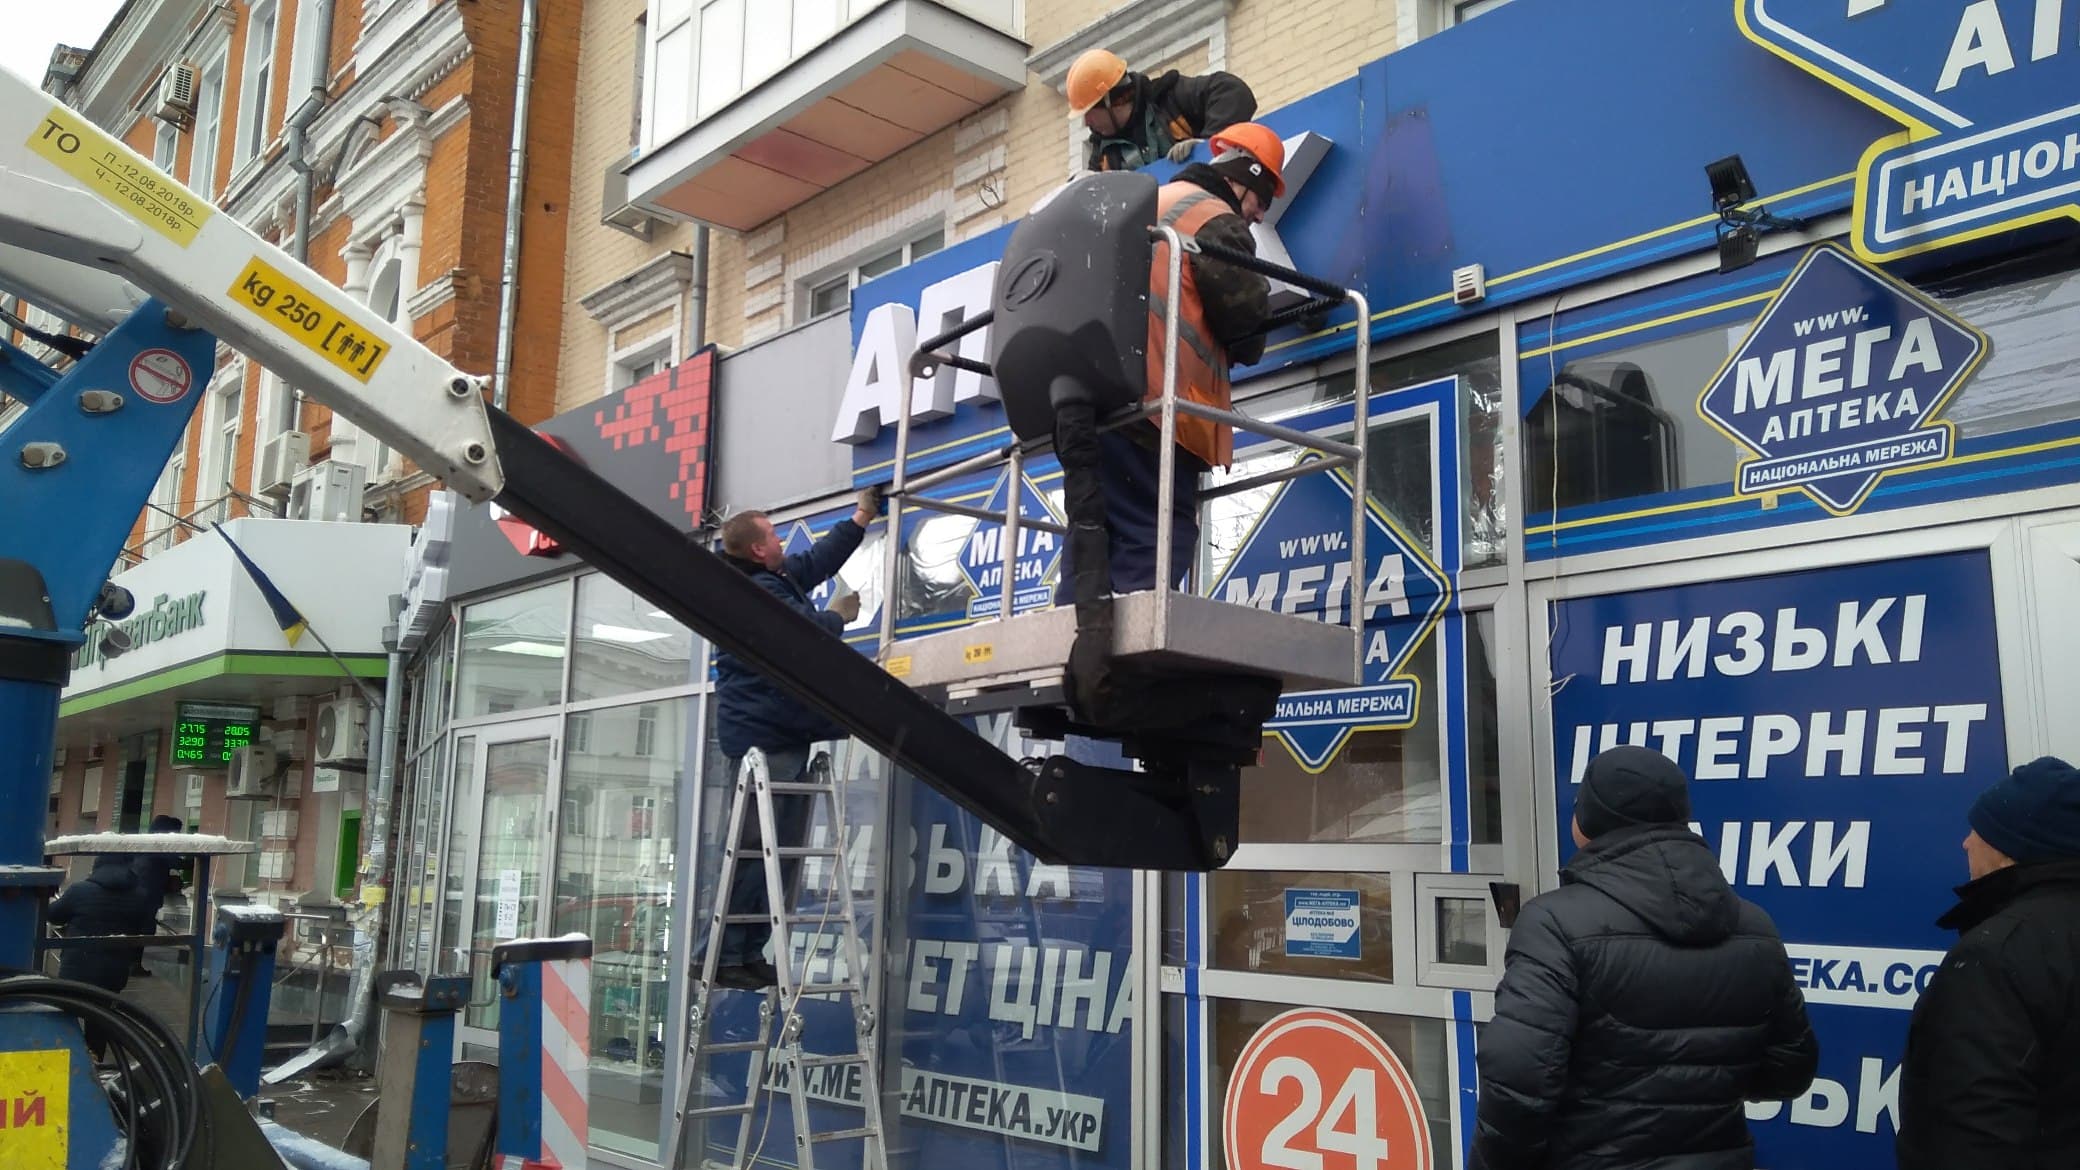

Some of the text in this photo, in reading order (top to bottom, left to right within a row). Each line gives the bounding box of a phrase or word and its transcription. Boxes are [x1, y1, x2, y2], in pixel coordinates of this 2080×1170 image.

[45, 118, 81, 154] ТО
[242, 271, 321, 332] kg 250
[1793, 306, 1869, 337] www.
[1733, 316, 1944, 415] МЕГА
[1761, 387, 1919, 446] АПТЕКА
[1749, 437, 1938, 485] НАЦІОНАЛЬНА МЕРЕЖА
[1279, 531, 1347, 559] www.
[980, 558, 1043, 589] АПЕКА
[1600, 594, 1927, 686] НИЗЬКІ
[1275, 694, 1404, 719] НАЛЬНА МЕРЕЖА
[1292, 916, 1354, 929] ЦІЛОДОБОВО
[1259, 1055, 1389, 1170] 24
